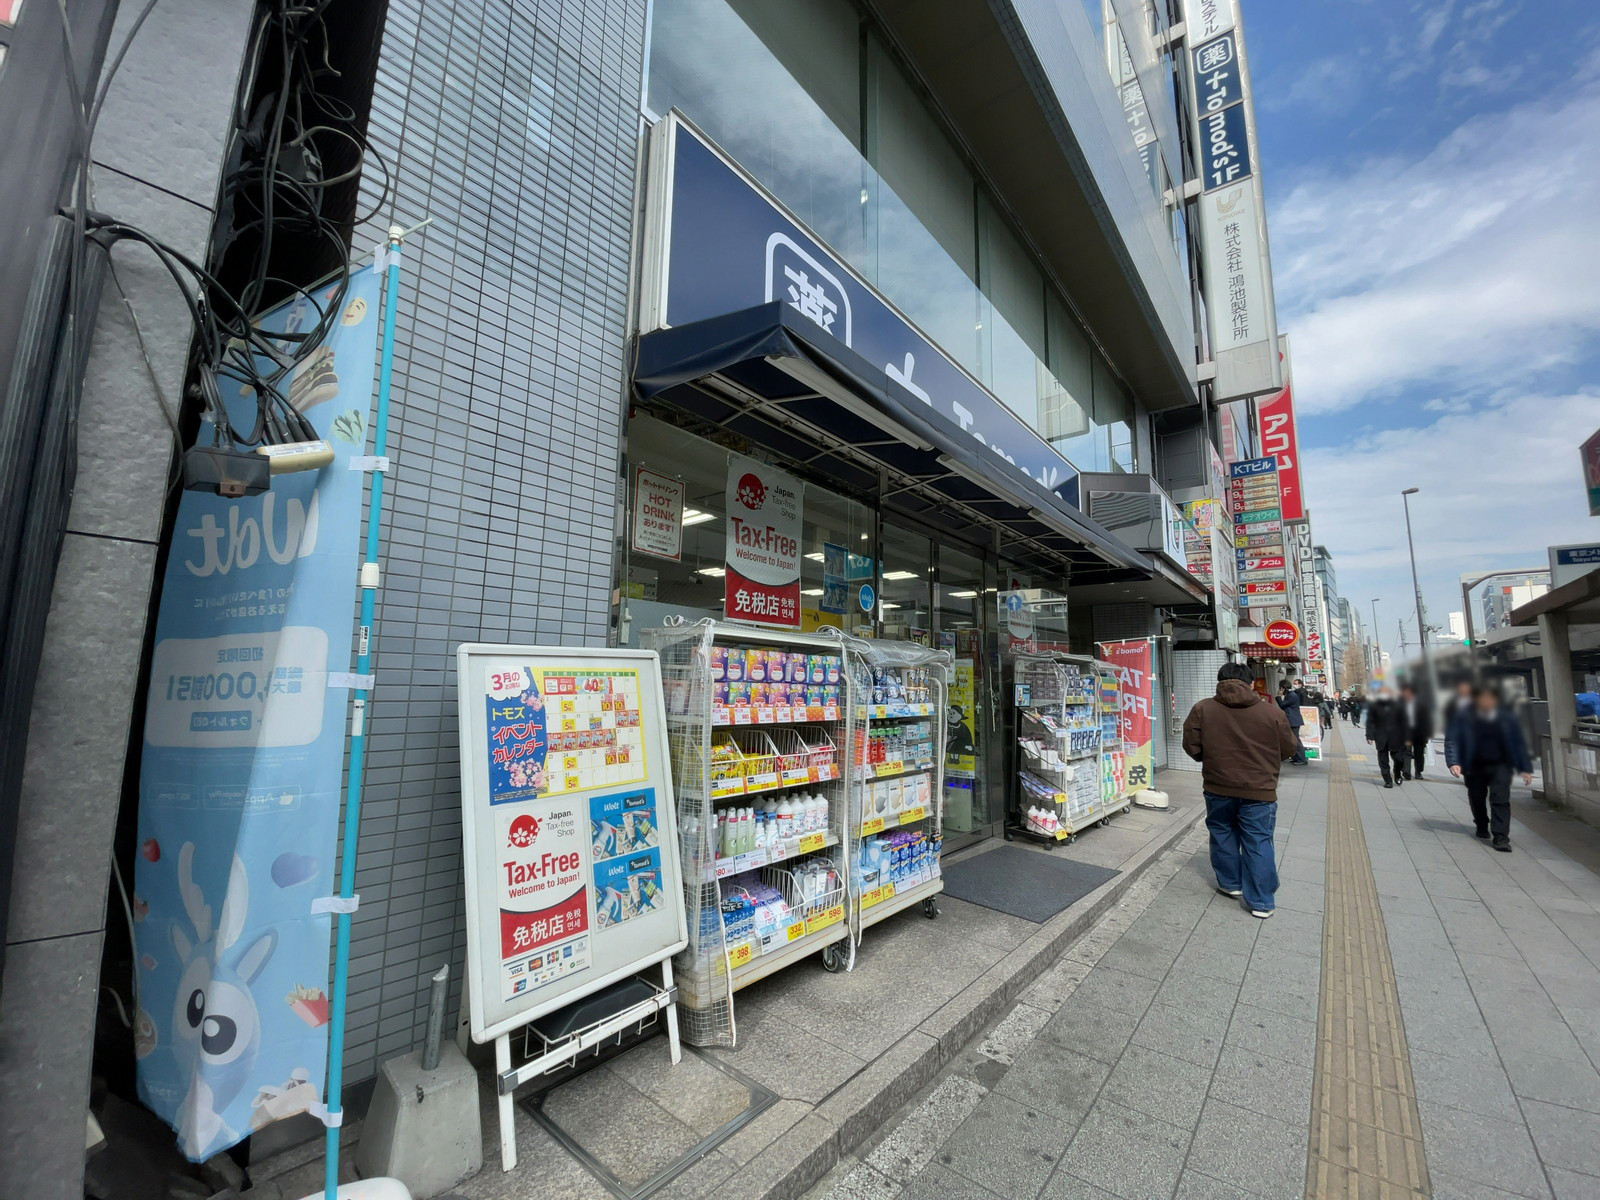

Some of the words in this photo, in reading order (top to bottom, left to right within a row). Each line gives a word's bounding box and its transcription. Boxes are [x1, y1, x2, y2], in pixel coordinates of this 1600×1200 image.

[1203, 43, 1227, 69] 薬
[1212, 163, 1240, 185] 1F
[1264, 413, 1293, 470] アコム
[649, 492, 672, 510] HOT
[772, 496, 796, 510] Tax-free
[643, 504, 675, 523] DRINK
[781, 507, 796, 520] Shop
[731, 516, 797, 558] Tax-Free
[736, 549, 767, 564] Welcome
[768, 556, 776, 566] to
[776, 557, 796, 571] Japan!
[735, 588, 780, 616] 免税店
[492, 707, 525, 721] トモズ
[493, 720, 543, 744] イベント
[493, 739, 543, 763] カレンダー
[548, 810, 574, 821] Japan.
[604, 802, 620, 812] Wolt
[546, 818, 574, 831] Tax-free
[557, 828, 575, 838] Shop
[503, 852, 580, 886] Tax-Free
[608, 865, 625, 877] Wolt
[508, 883, 546, 899] Welcome
[547, 880, 556, 889] to
[828, 907, 842, 918] 598
[512, 915, 564, 950] 免税店
[736, 946, 748, 959] 398
